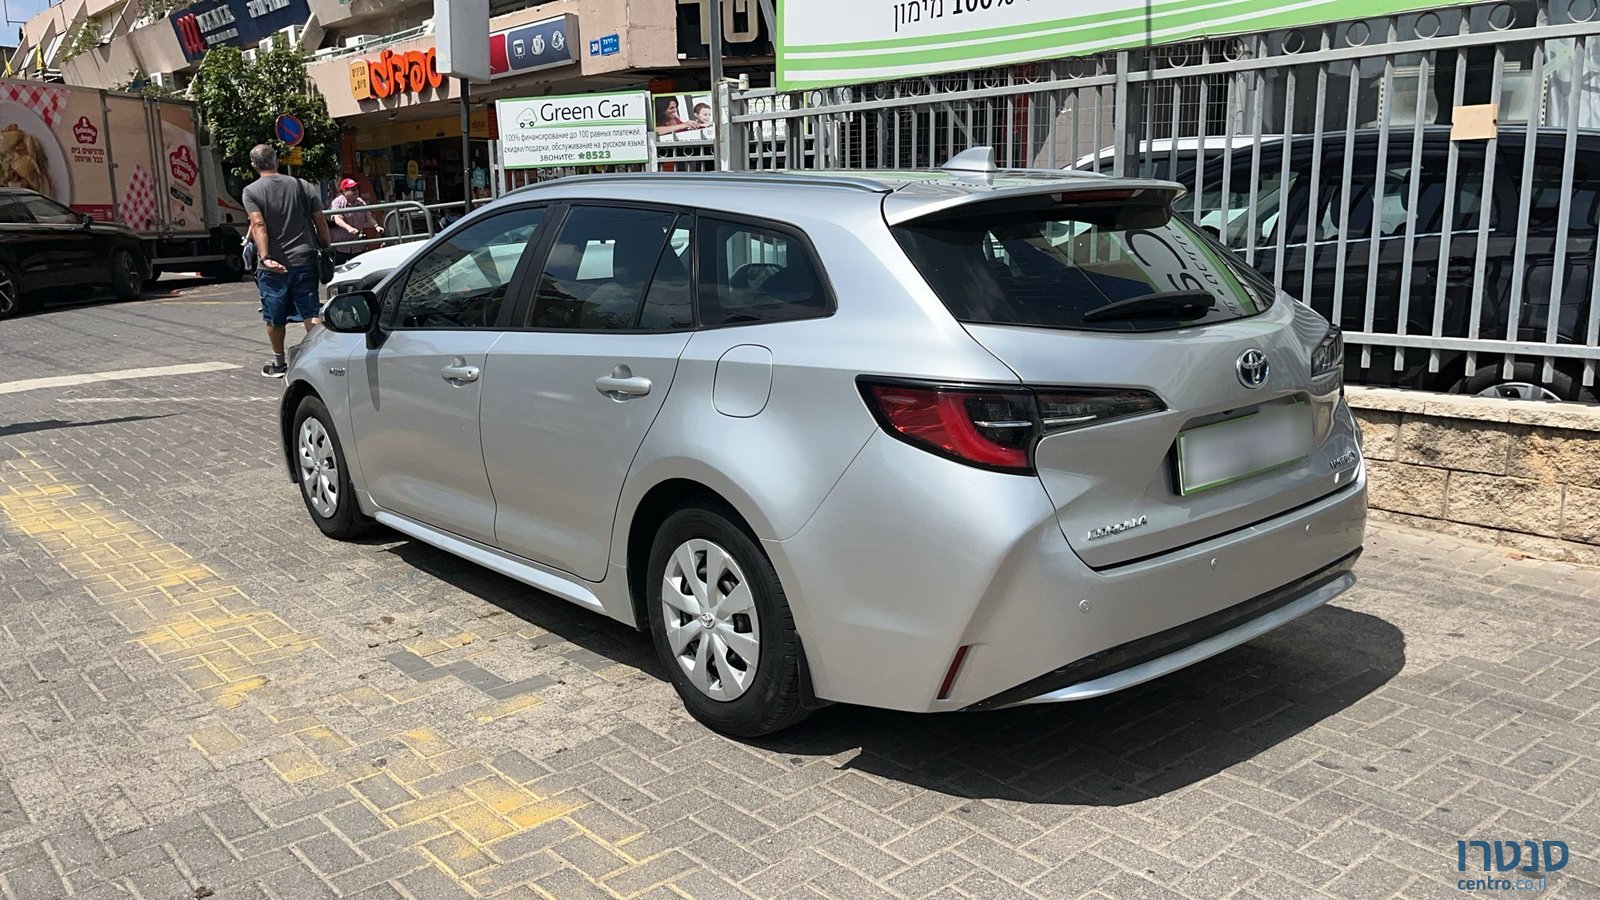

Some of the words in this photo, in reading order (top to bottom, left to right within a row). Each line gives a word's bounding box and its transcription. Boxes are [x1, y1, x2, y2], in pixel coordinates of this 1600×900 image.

[893, 0, 943, 32] מימון
[591, 42, 599, 53] 30
[540, 103, 594, 122] Green
[597, 99, 629, 119] Car
[505, 132, 520, 142] 100%
[521, 132, 569, 143] финансирование
[569, 132, 577, 140] до
[578, 130, 589, 139] 100
[590, 130, 612, 139] равных
[551, 141, 593, 152] обслуживание
[602, 140, 627, 150] русском
[539, 153, 575, 162] звоните:
[1087, 514, 1148, 540] COROLLA
